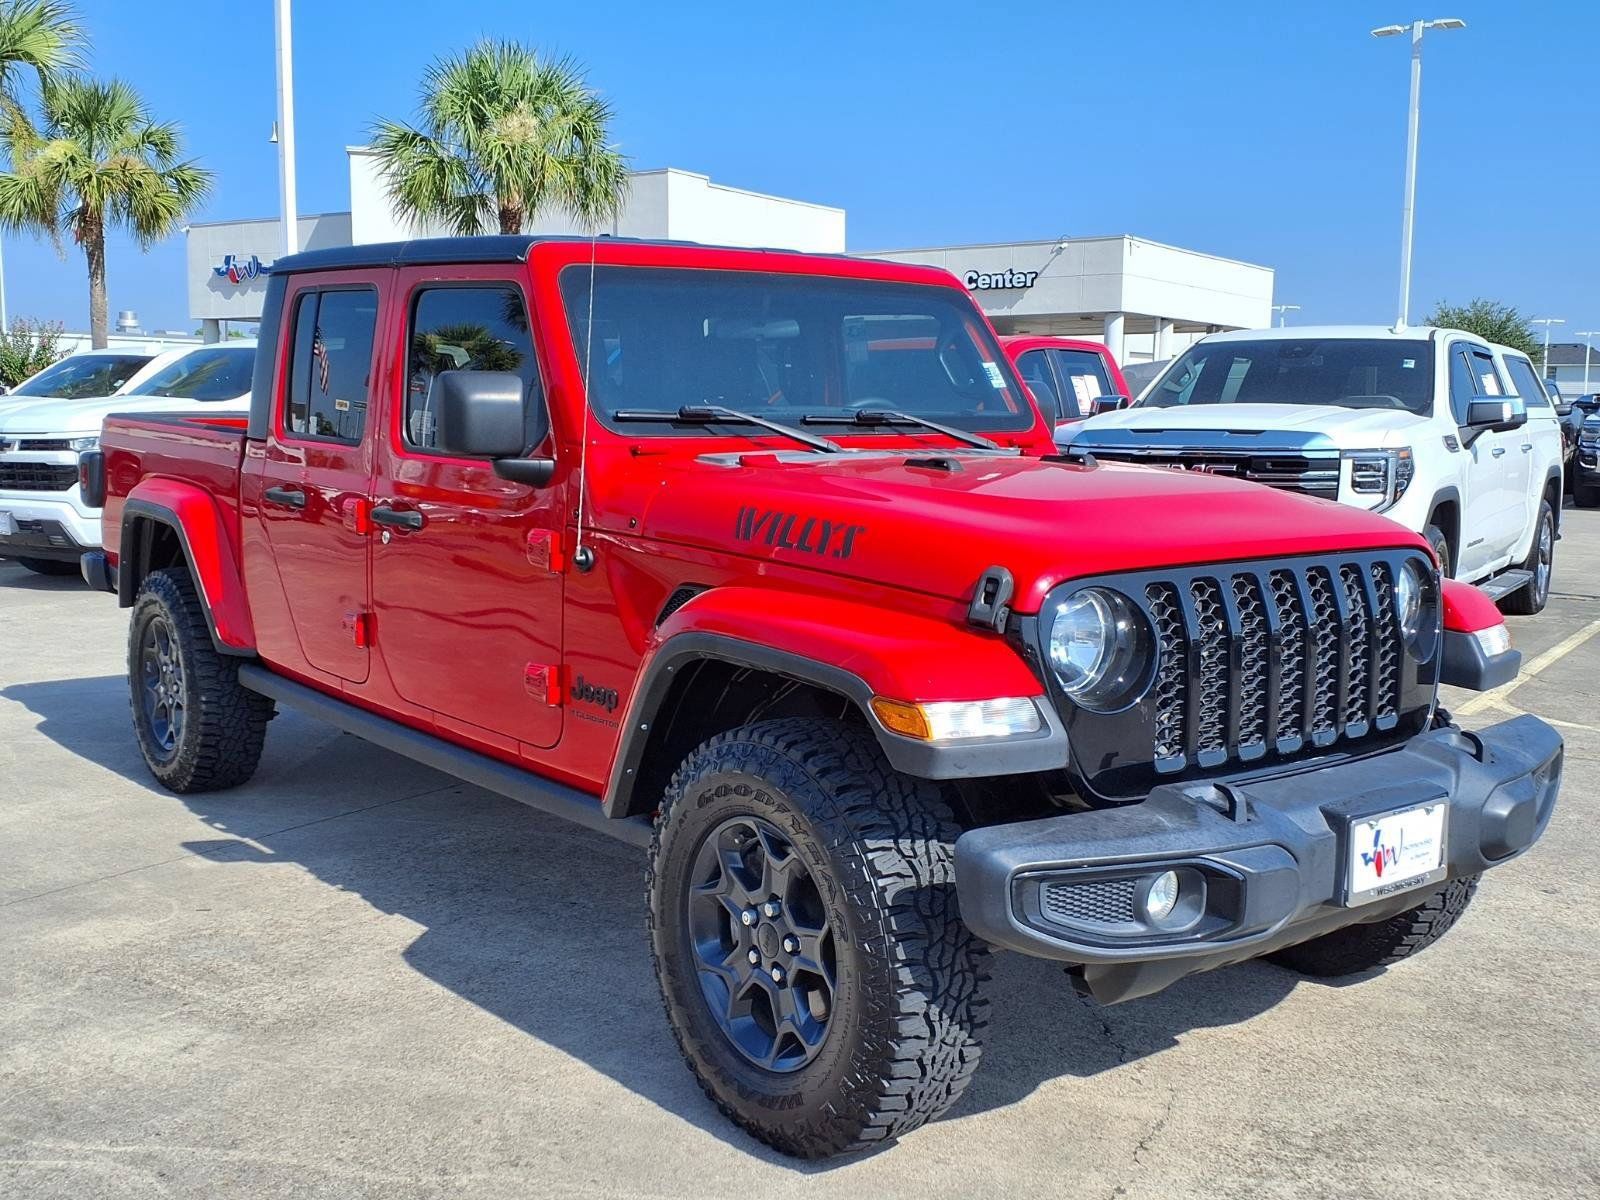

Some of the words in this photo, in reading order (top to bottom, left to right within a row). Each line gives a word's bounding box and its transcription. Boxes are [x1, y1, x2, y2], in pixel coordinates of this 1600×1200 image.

[963, 267, 1039, 291] Center
[735, 506, 867, 559] WILLYS
[571, 673, 619, 714] Jeep
[697, 783, 849, 943] GOODYEAR
